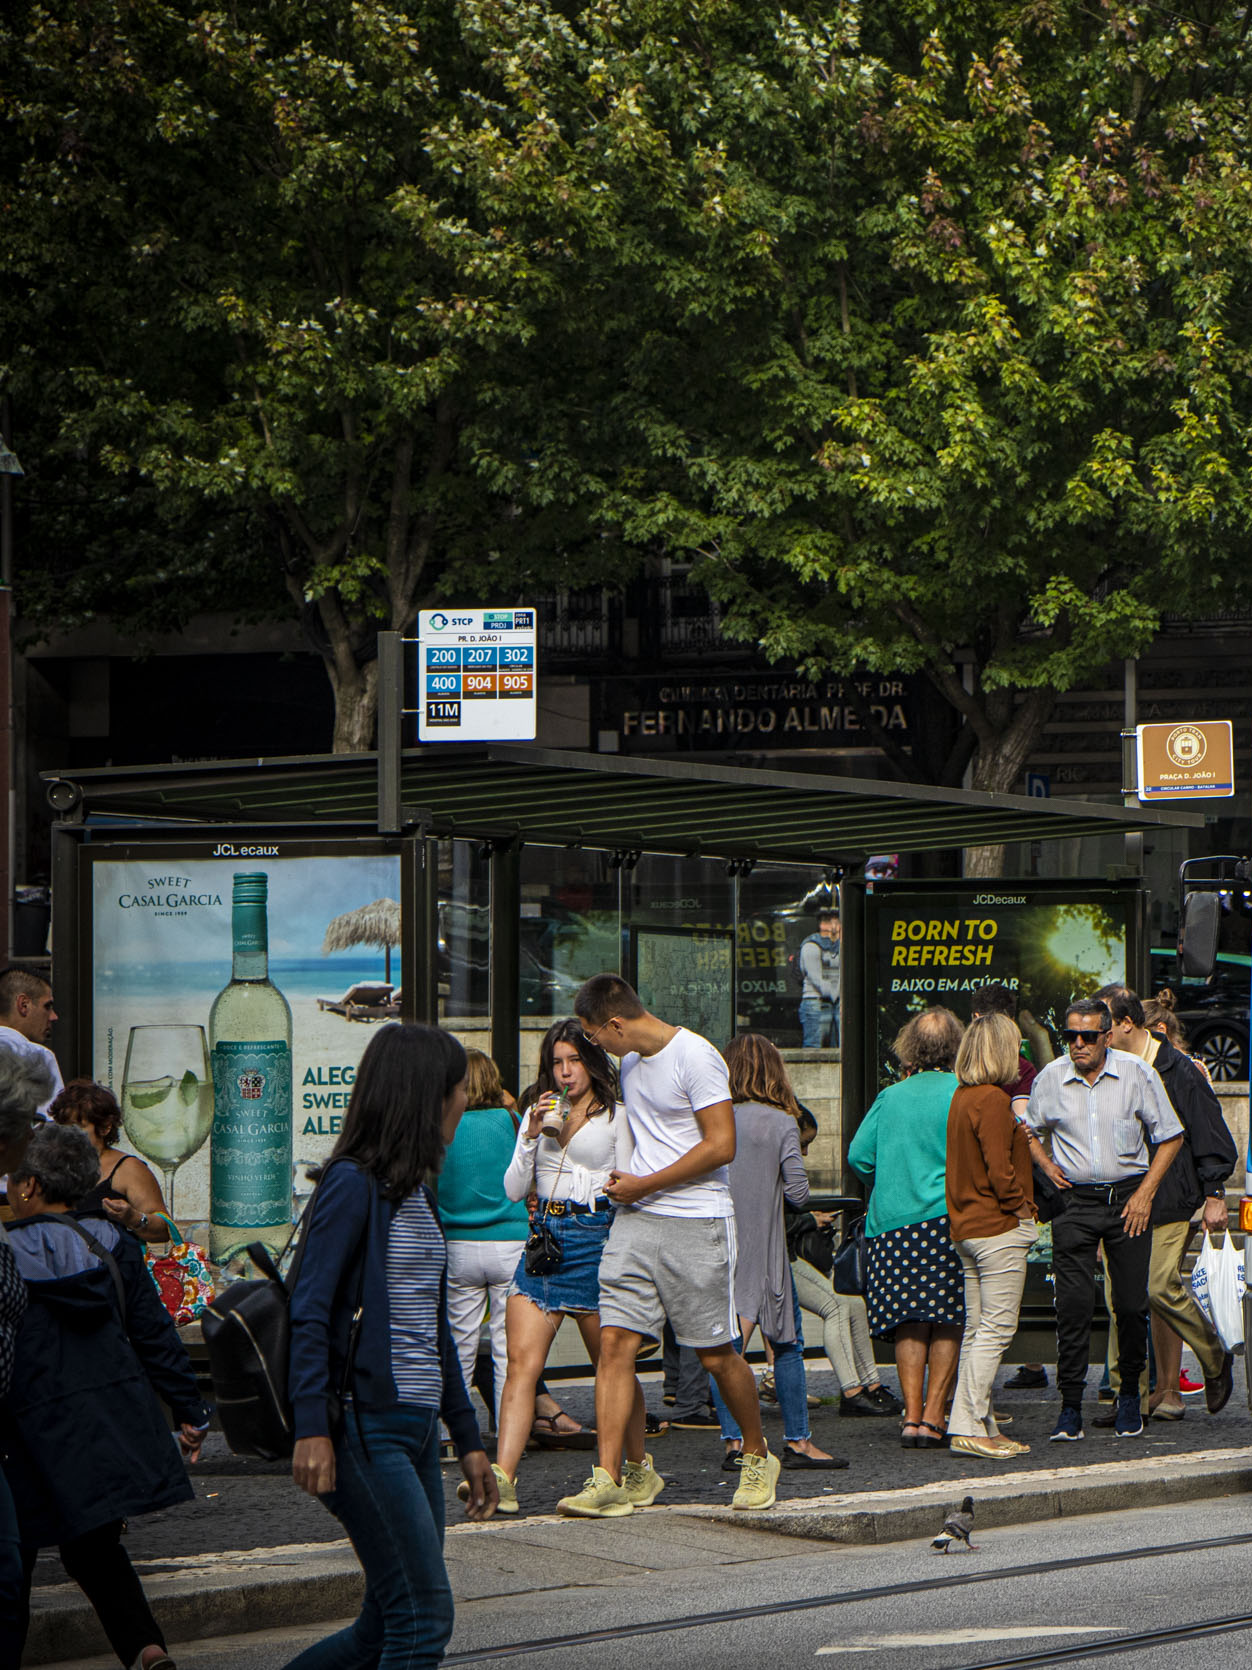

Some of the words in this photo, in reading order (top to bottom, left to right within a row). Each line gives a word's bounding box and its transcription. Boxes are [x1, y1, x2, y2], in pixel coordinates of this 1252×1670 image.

[451, 618, 474, 626] STCP
[515, 617, 530, 625] PRT1
[478, 634, 498, 642] JOÃO
[431, 650, 456, 663] 200
[467, 649, 492, 662] 207
[504, 649, 528, 661] 302
[431, 677, 456, 690] 400
[467, 676, 492, 689] 904
[503, 676, 528, 689] 905
[879, 681, 908, 697] DR.
[429, 703, 459, 717] 11M
[623, 706, 777, 736] FERNANDO
[784, 704, 909, 731] ALMEDA
[1171, 728, 1187, 741] PORTO
[1189, 728, 1202, 740] TRAM
[1172, 754, 1185, 764] CITY
[1188, 753, 1202, 764] TOUR
[1192, 771, 1211, 779] JOÃO
[147, 876, 191, 889] SWEET
[119, 894, 164, 908] CASAL
[166, 894, 223, 908] GARCIA
[973, 895, 1027, 905] JCDecaux
[891, 920, 960, 941] BORN
[965, 919, 998, 940] TO
[891, 945, 994, 966] REFRESH
[891, 979, 935, 992] BAIXO
[937, 979, 959, 992] EM
[236, 1109, 268, 1118] SWEET
[213, 1122, 244, 1135] CASAL
[247, 1121, 289, 1136] GARCIA
[227, 1174, 253, 1182] VINHO
